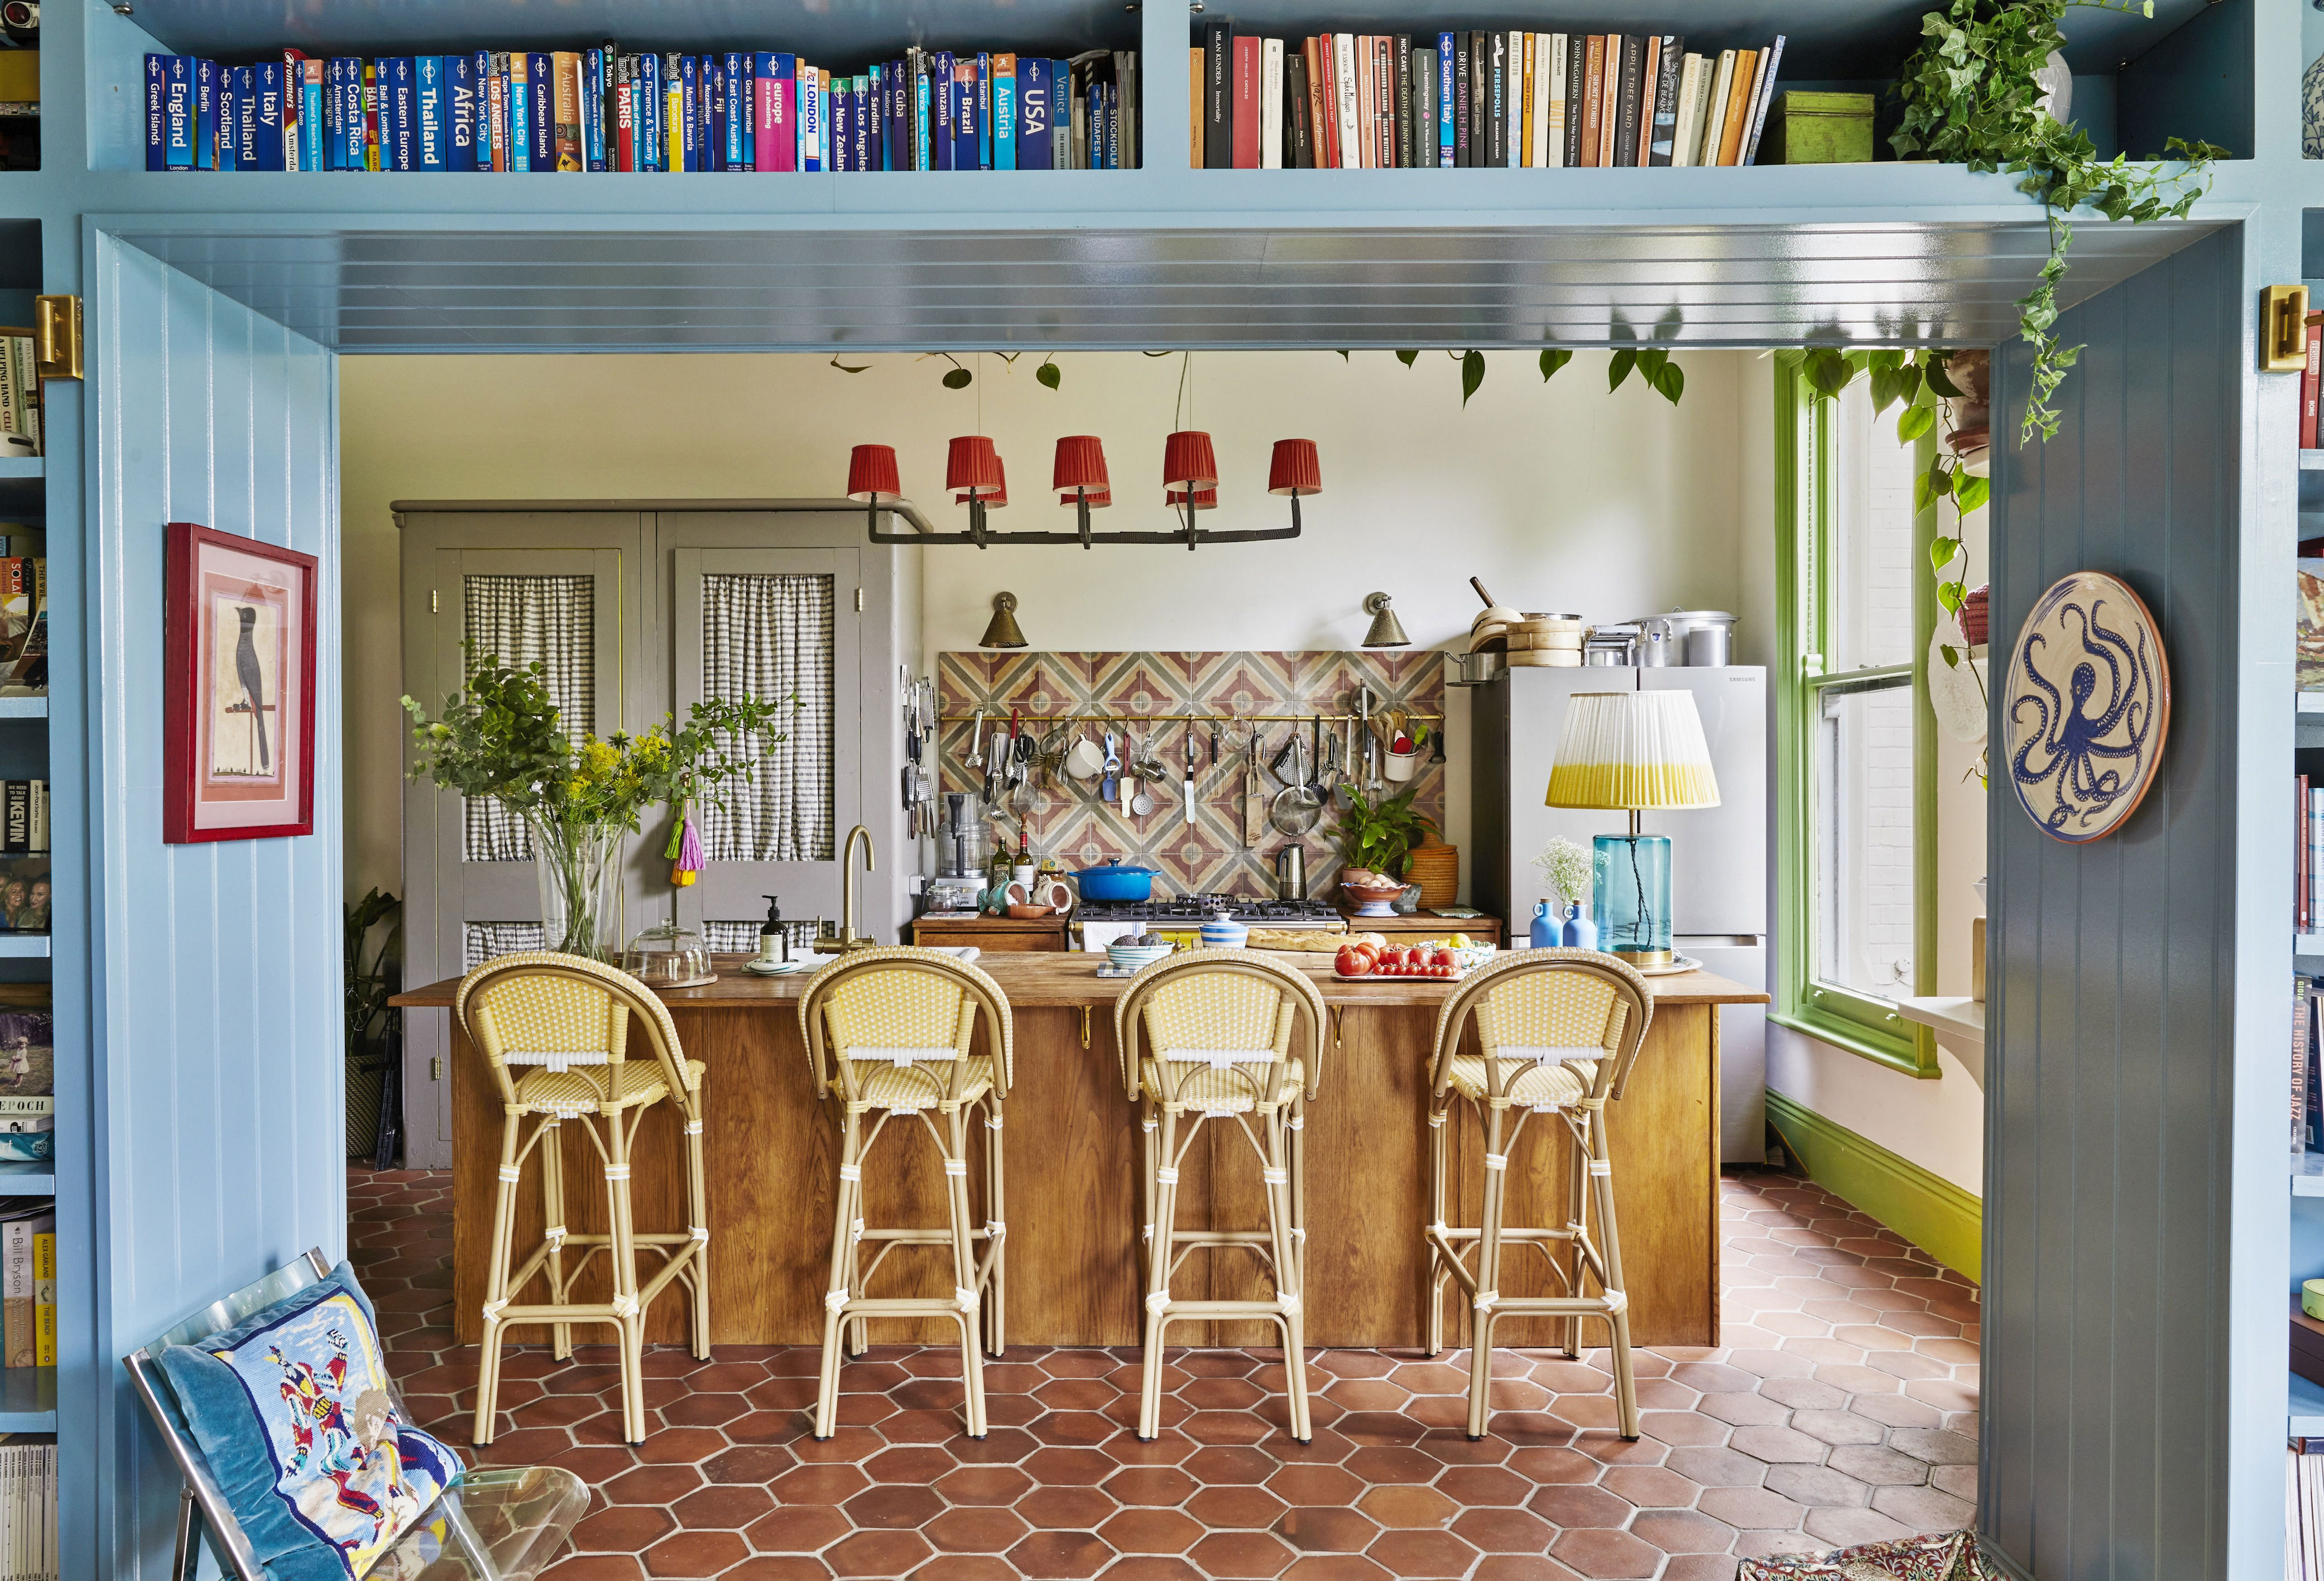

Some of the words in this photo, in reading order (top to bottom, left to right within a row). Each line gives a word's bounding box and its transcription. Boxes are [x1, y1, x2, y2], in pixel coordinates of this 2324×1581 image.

[605, 64, 613, 88] Tokyo
[1663, 53, 1672, 78] SIMONE
[150, 83, 160, 111] Greek
[200, 86, 210, 112] Berlin
[379, 85, 387, 102] Bali
[478, 78, 486, 98] New
[491, 81, 500, 100] LOS
[562, 72, 573, 122] Australia
[645, 81, 653, 117] Florence
[1057, 76, 1067, 113] Venice
[1669, 74, 1677, 92] Came
[168, 83, 187, 147] England
[260, 92, 279, 126] Italy
[334, 84, 343, 134] Amsterdam
[347, 84, 360, 123] Costa
[398, 88, 408, 128] Eastern
[454, 86, 474, 146] Africa
[478, 100, 487, 121] York
[516, 108, 525, 129] York
[537, 84, 546, 127] Caribbean
[618, 88, 631, 129] PARIS
[714, 98, 724, 112] Fiji
[729, 98, 738, 122] Coast
[772, 82, 782, 124] europe
[807, 84, 816, 133] LONDON
[871, 97, 880, 134] Sardinia
[896, 89, 906, 117] Cuba
[939, 80, 949, 126] Tanzania
[962, 97, 974, 134] Brazil
[998, 87, 1011, 138] Austria
[1025, 90, 1045, 135] USA
[1402, 110, 1408, 118] OF
[1442, 103, 1452, 124] Italy
[1658, 90, 1668, 119] BEAUVOIR
[1665, 99, 1674, 112] Stay
[151, 113, 161, 146] Islands
[220, 92, 233, 149] Scotland
[242, 95, 256, 161] Thailand
[380, 112, 390, 145] Lombok
[422, 88, 440, 164] Thailand
[478, 124, 488, 142] City
[491, 103, 502, 150] ANGELES
[836, 108, 846, 132] New
[1459, 117, 1467, 126] H.
[287, 131, 296, 171] Amsterda
[349, 127, 361, 156] Rica
[398, 131, 409, 170] Europe
[516, 131, 525, 146] City
[538, 129, 548, 158] Islands
[645, 127, 654, 161] Tuscany
[730, 123, 738, 159] Australia
[856, 129, 868, 172] Angeles
[1459, 128, 1467, 149] PINK
[1, 383, 10, 408] HAND
[9, 801, 25, 843] KEVIN
[2294, 1006, 2306, 1026] THE
[2292, 1031, 2305, 1074] HISTORY
[2291, 1078, 2302, 1092] OF
[2290, 1096, 2302, 1121] JAZZ
[12, 1237, 23, 1253] Bill
[12, 1257, 24, 1294] Bryson
